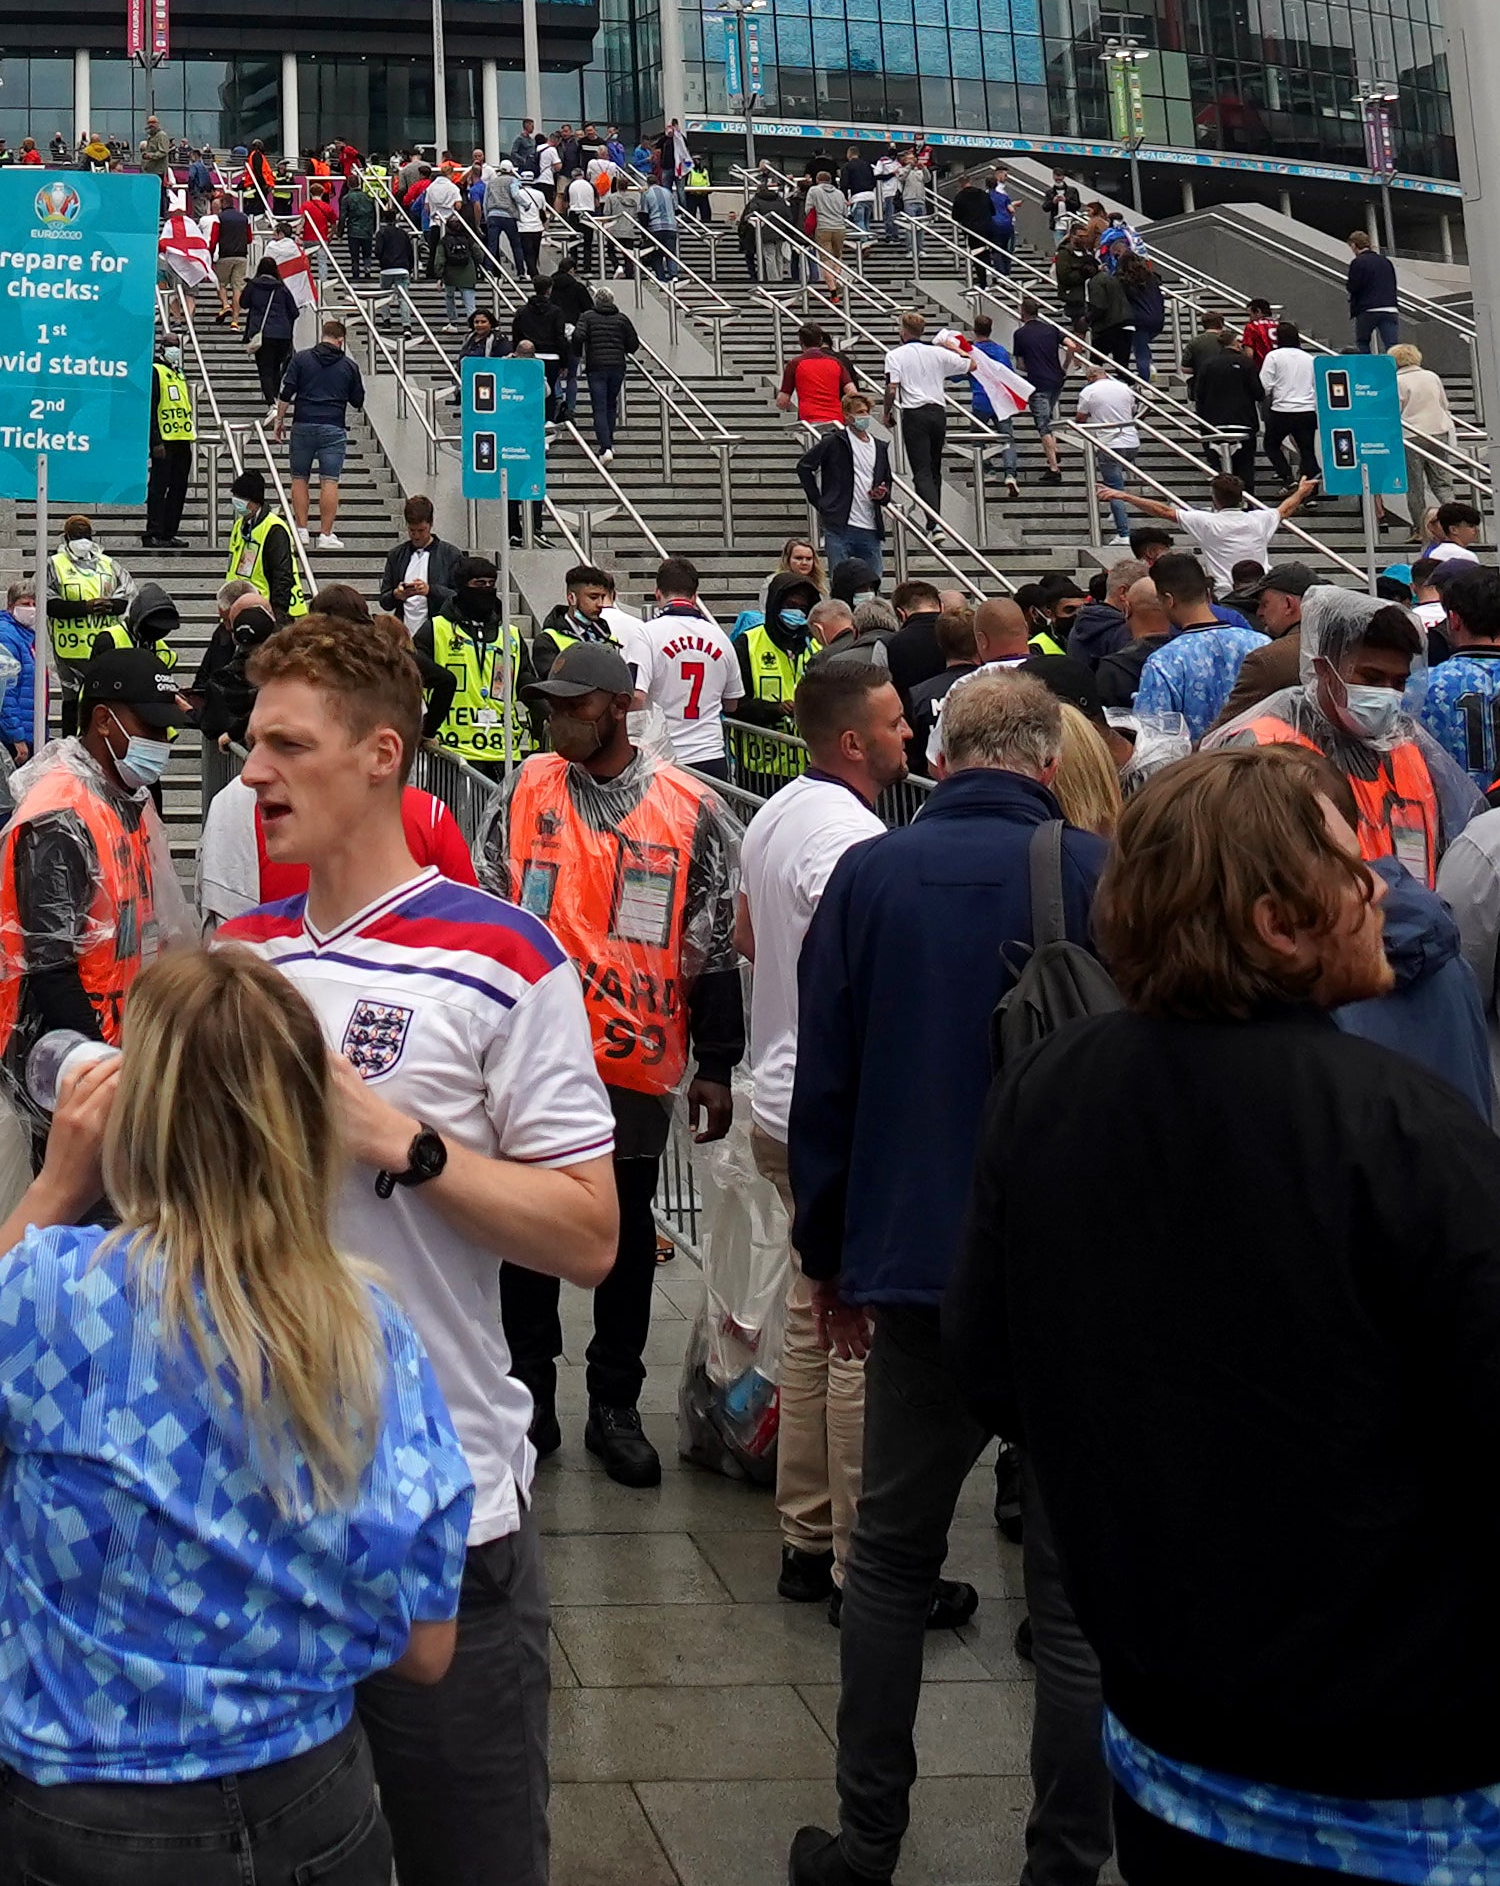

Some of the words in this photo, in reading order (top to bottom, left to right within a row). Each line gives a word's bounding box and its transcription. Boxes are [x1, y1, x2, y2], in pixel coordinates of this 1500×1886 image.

[776, 125, 802, 135] 2020
[90, 251, 128, 273] for
[7, 276, 100, 301] checks:
[48, 354, 128, 377] status
[0, 427, 89, 452] Tickets
[662, 635, 723, 662] BECKHAM
[681, 661, 705, 720] 7
